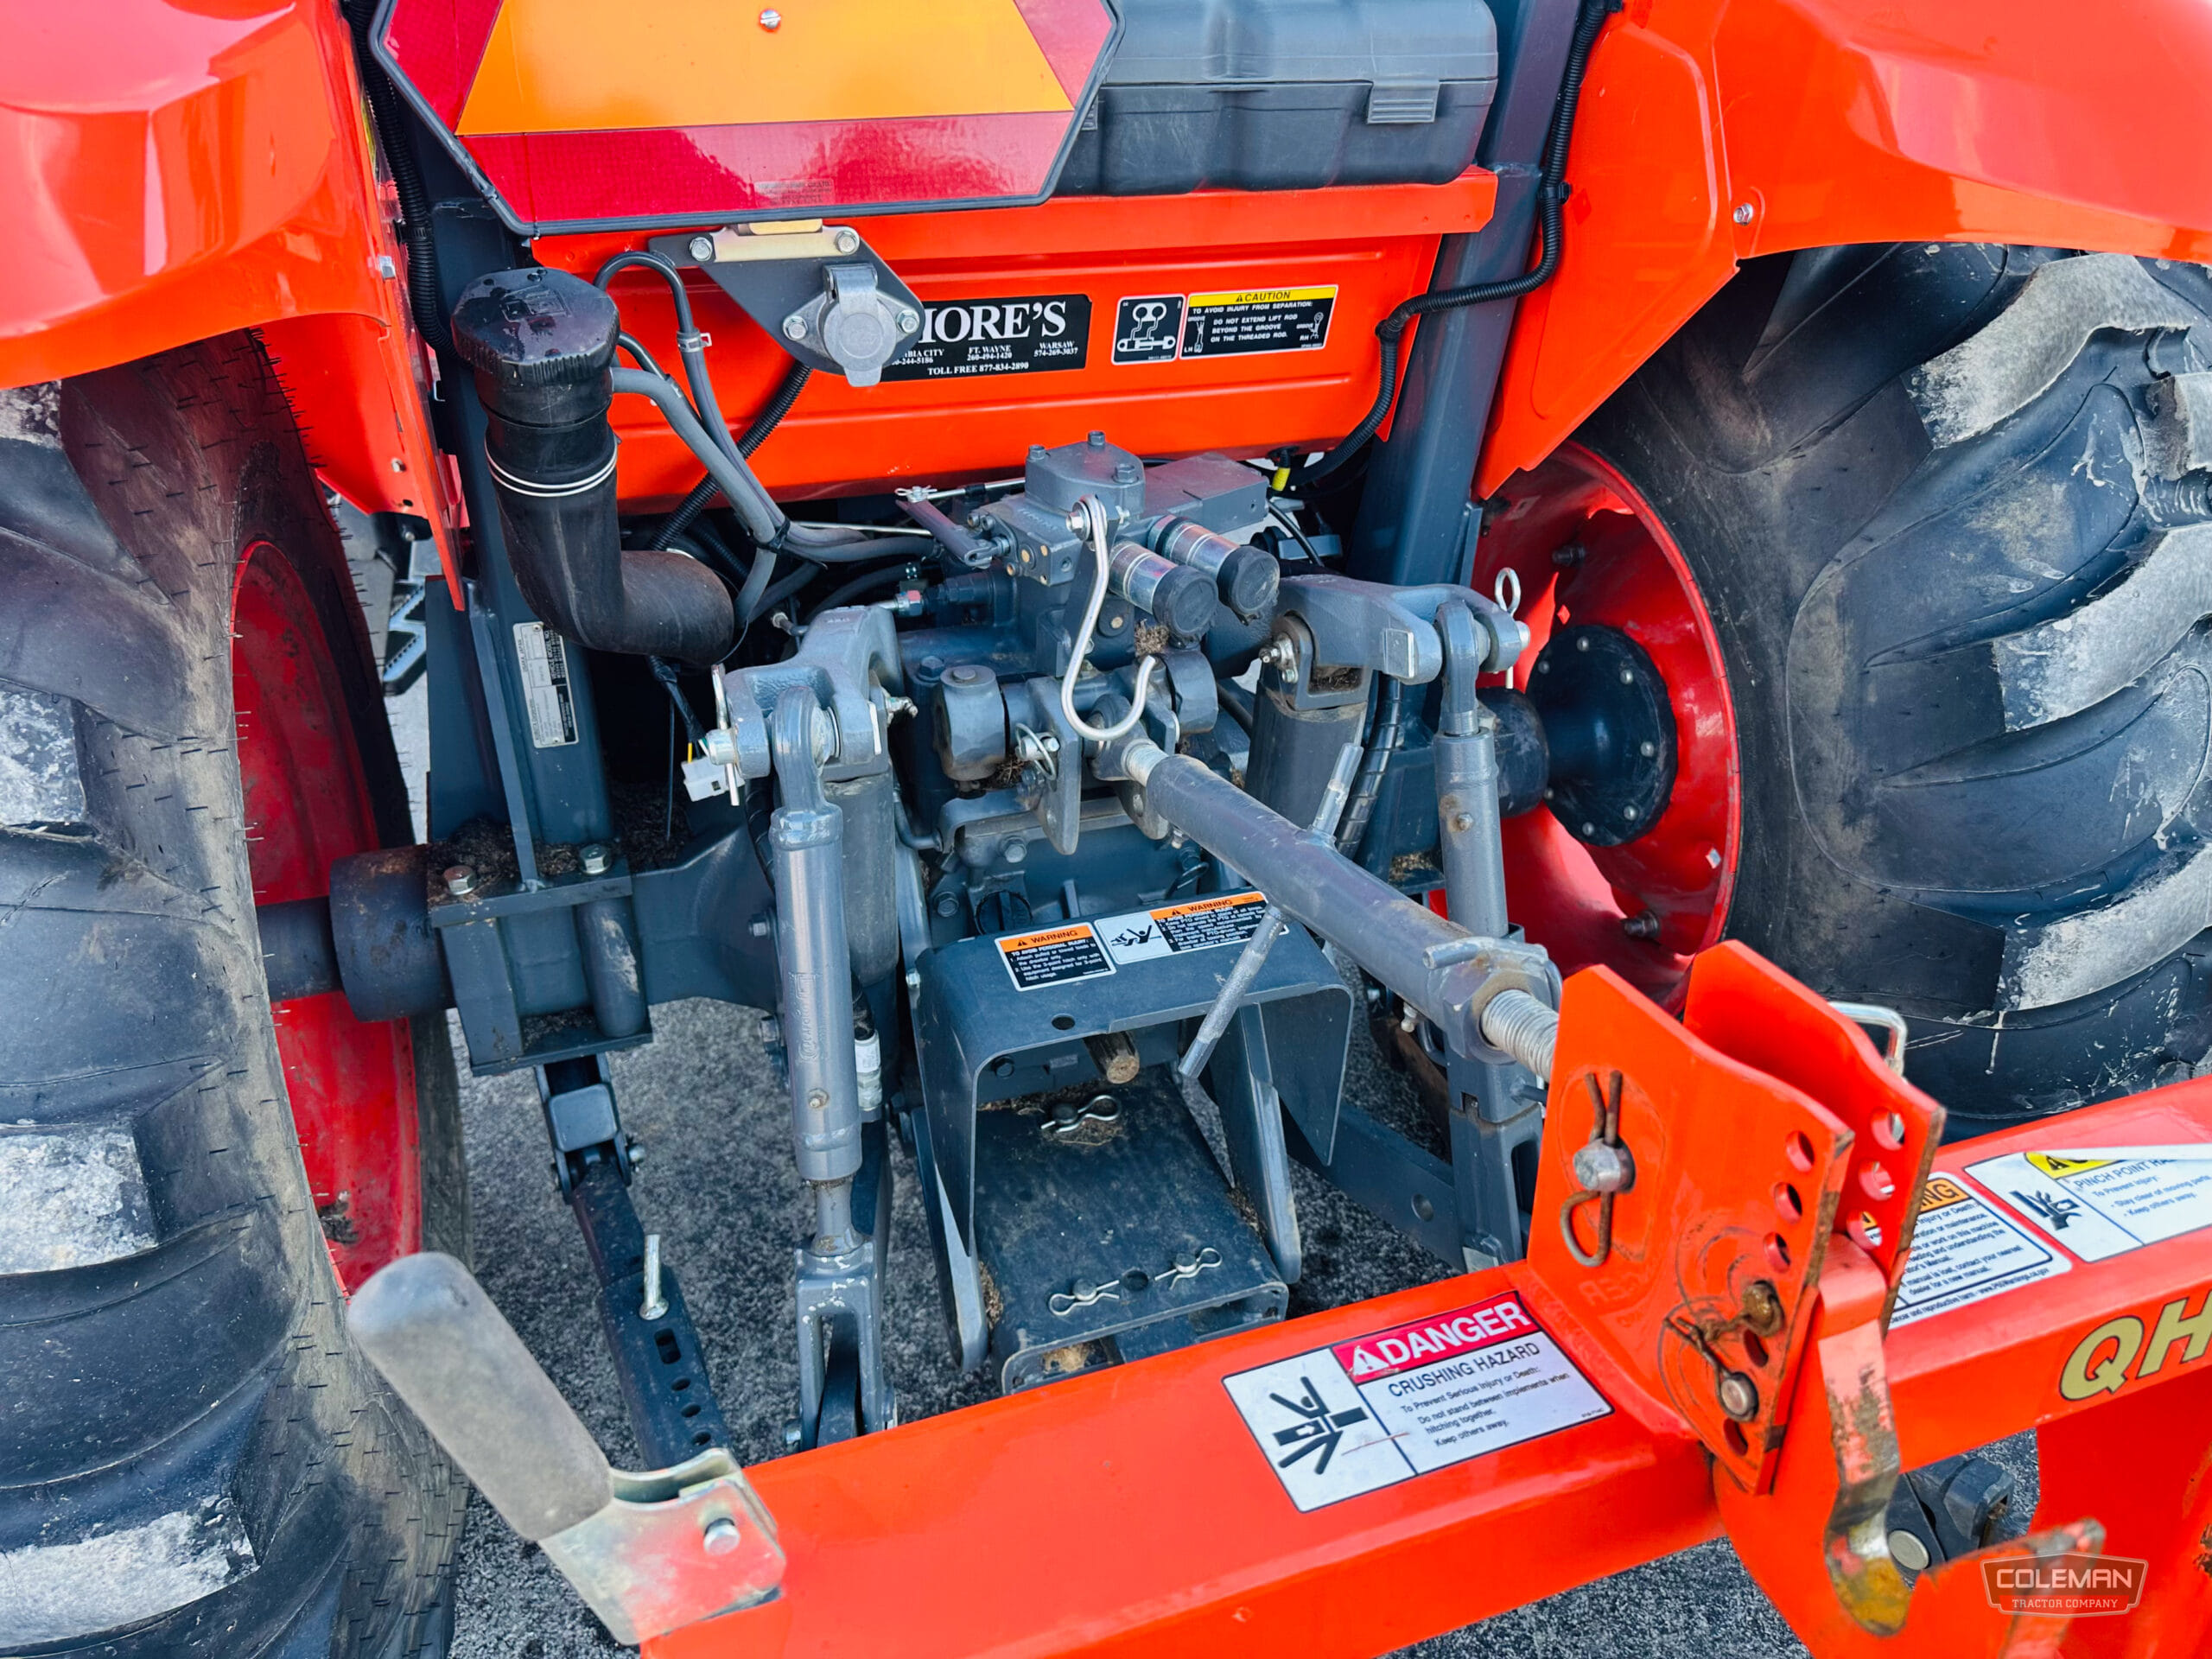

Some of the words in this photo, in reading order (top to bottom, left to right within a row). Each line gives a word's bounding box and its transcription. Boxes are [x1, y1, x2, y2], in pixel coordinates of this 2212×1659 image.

[1244, 291, 1291, 302] CAUTION
[982, 345, 1011, 353] WAYNE
[1039, 340, 1075, 349] WARSAW
[923, 348, 944, 357] CITY
[967, 352, 1013, 361] 260-494-1420
[927, 366, 952, 376] TOLL
[954, 365, 978, 374] FREE
[979, 362, 1029, 372] 877-834-2890
[1188, 899, 1232, 911] WARNING
[1031, 931, 1077, 943] WARNING
[2074, 1173, 2114, 1188] PINCH
[2113, 1161, 2149, 1177] POINT
[2127, 1206, 2149, 1215] Keep
[1376, 1301, 1531, 1365] DANGER
[1389, 1363, 1473, 1396] CRUSHING
[1474, 1343, 1540, 1370] HAZARD
[1413, 1395, 1446, 1409] Prevent
[1446, 1386, 1478, 1399] Serious
[1478, 1378, 1503, 1389] Injury
[1513, 1367, 1540, 1378] Death:
[1432, 1410, 1446, 1420] not
[1446, 1402, 1470, 1415] stand
[1469, 1394, 1503, 1408] between
[1503, 1380, 1548, 1396] implements
[1548, 1373, 1569, 1382] when
[1425, 1420, 1460, 1433] hitching
[1459, 1408, 1496, 1422] together.
[1434, 1436, 1457, 1446] Keep
[1458, 1427, 1484, 1439] others
[1485, 1420, 1509, 1430] away.
